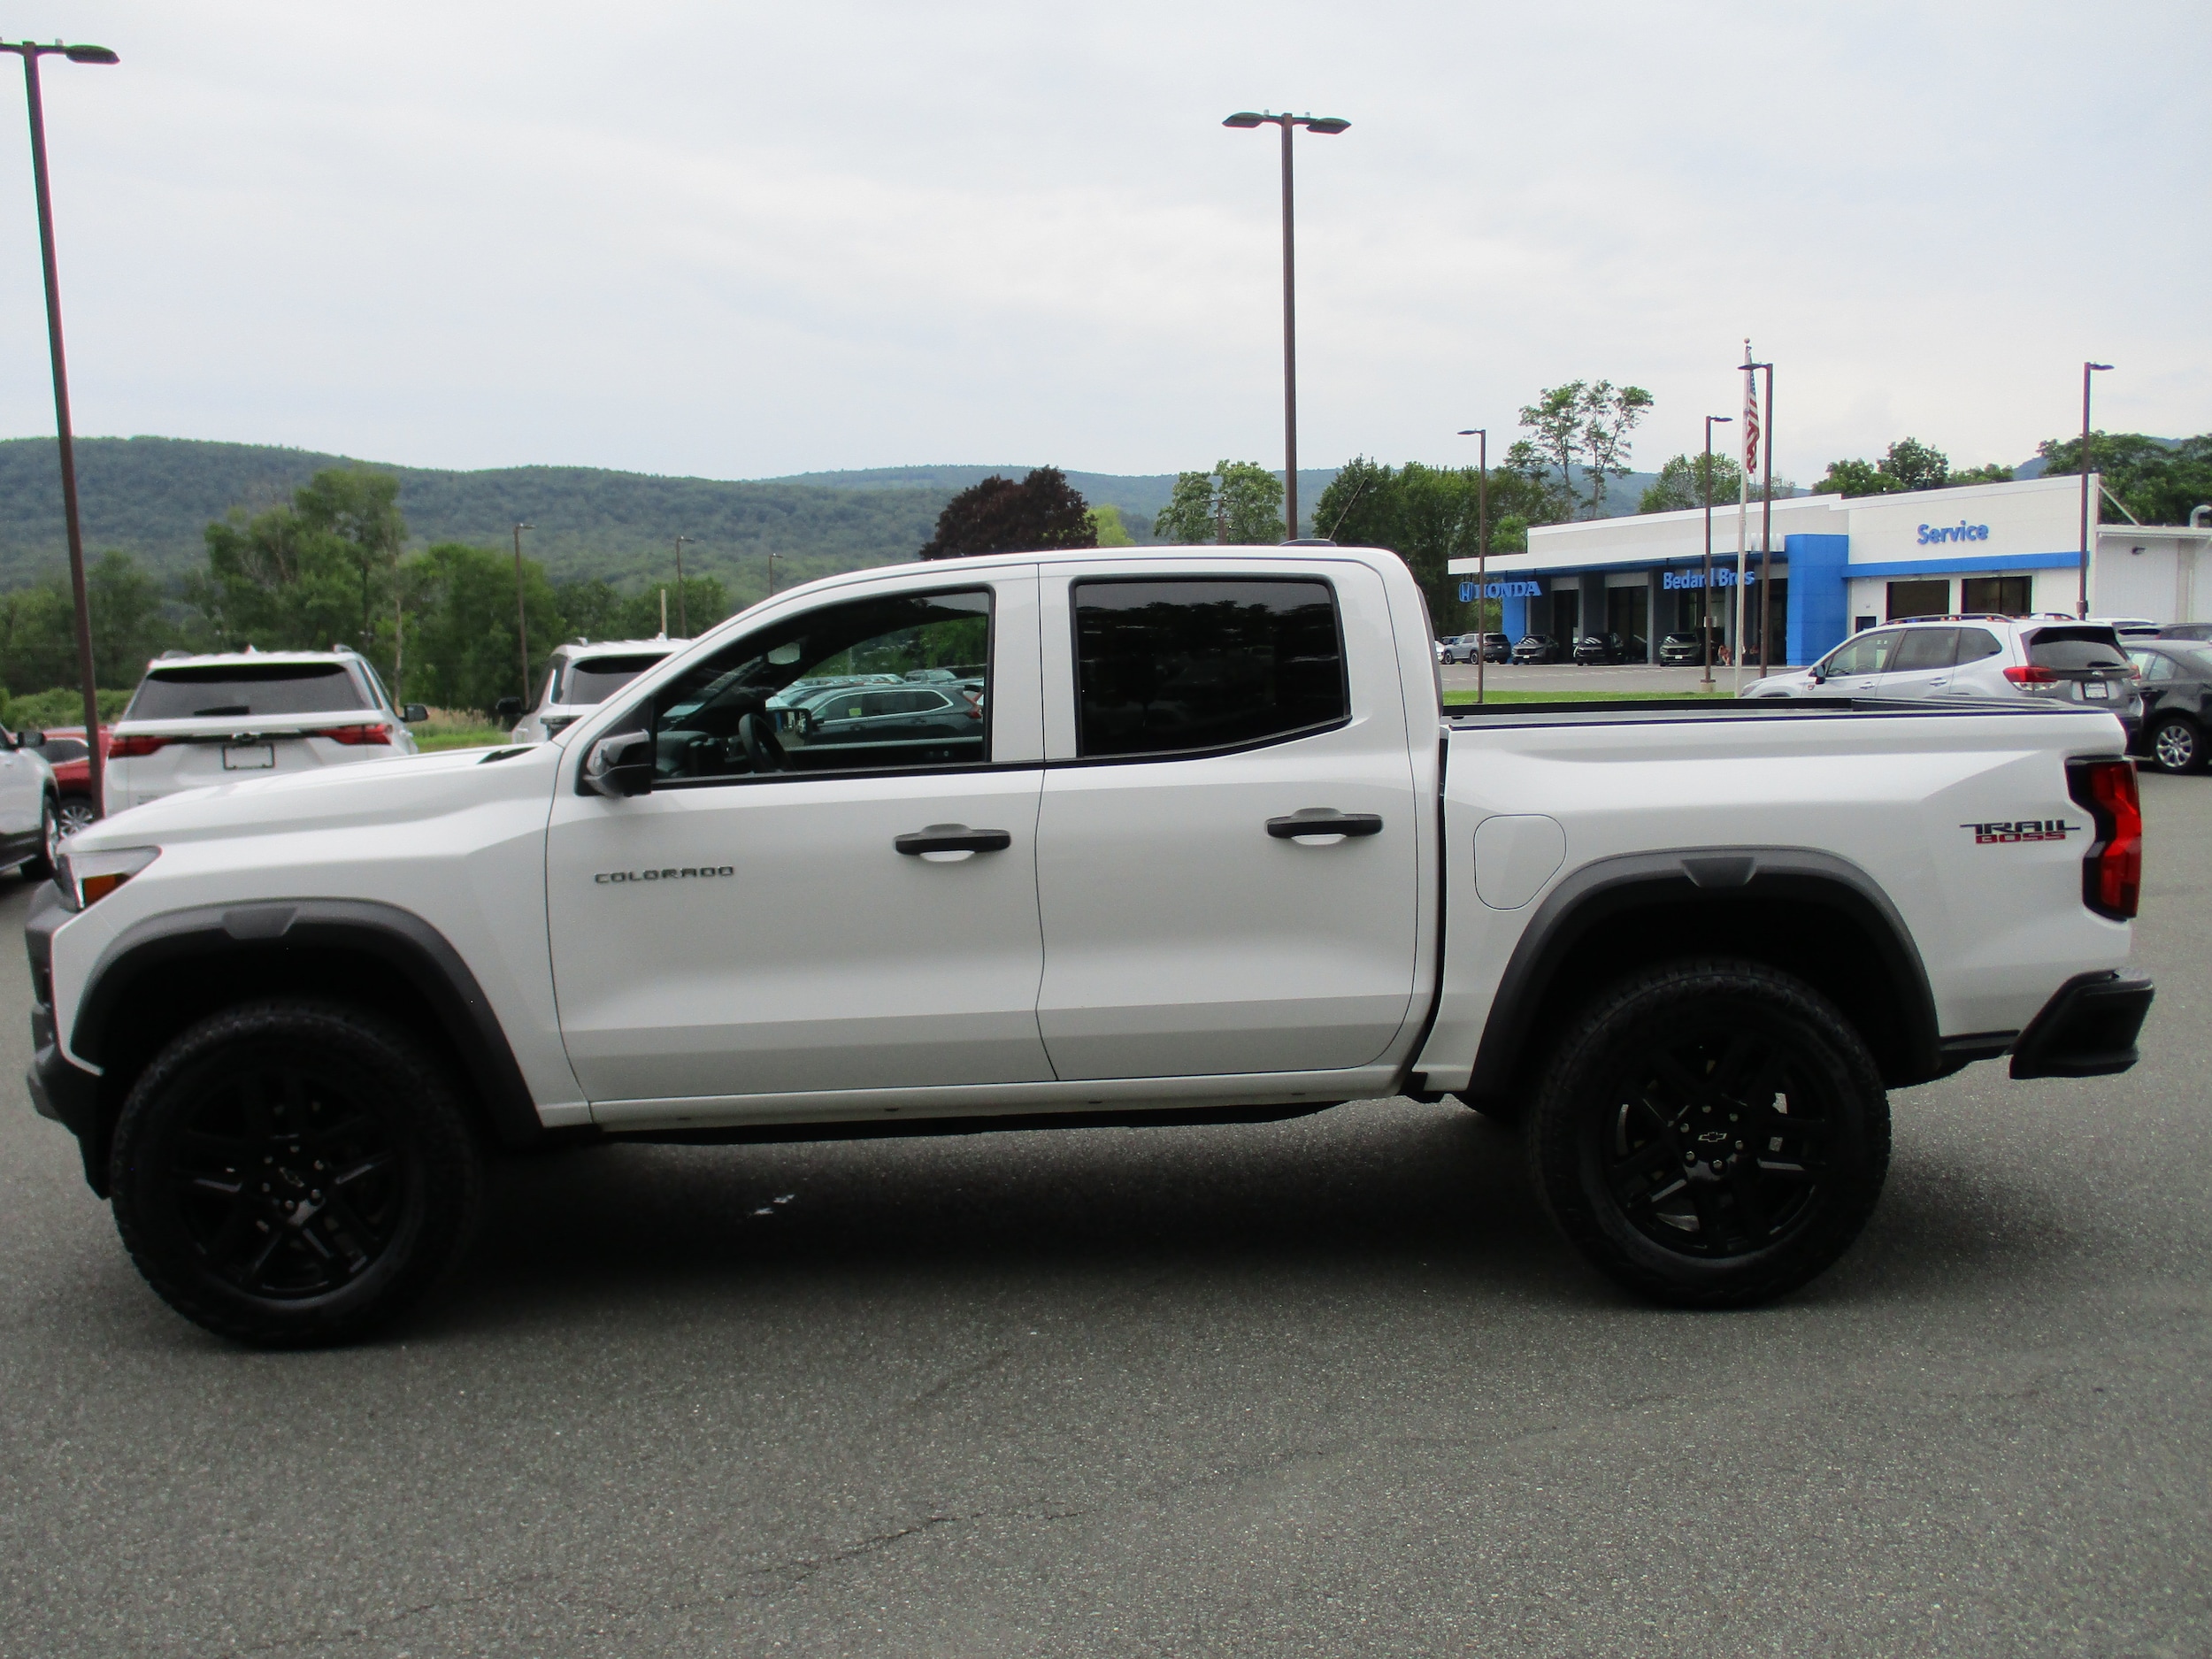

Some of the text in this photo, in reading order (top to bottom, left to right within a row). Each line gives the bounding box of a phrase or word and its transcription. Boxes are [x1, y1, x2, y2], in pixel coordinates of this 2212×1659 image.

[1916, 519, 1989, 545] Service
[1718, 567, 1755, 588] Brs
[1474, 580, 1542, 600] HONDA
[1960, 819, 2081, 834] TRAIL
[1976, 831, 2067, 844] BOSS
[595, 865, 734, 884] COLORADO
